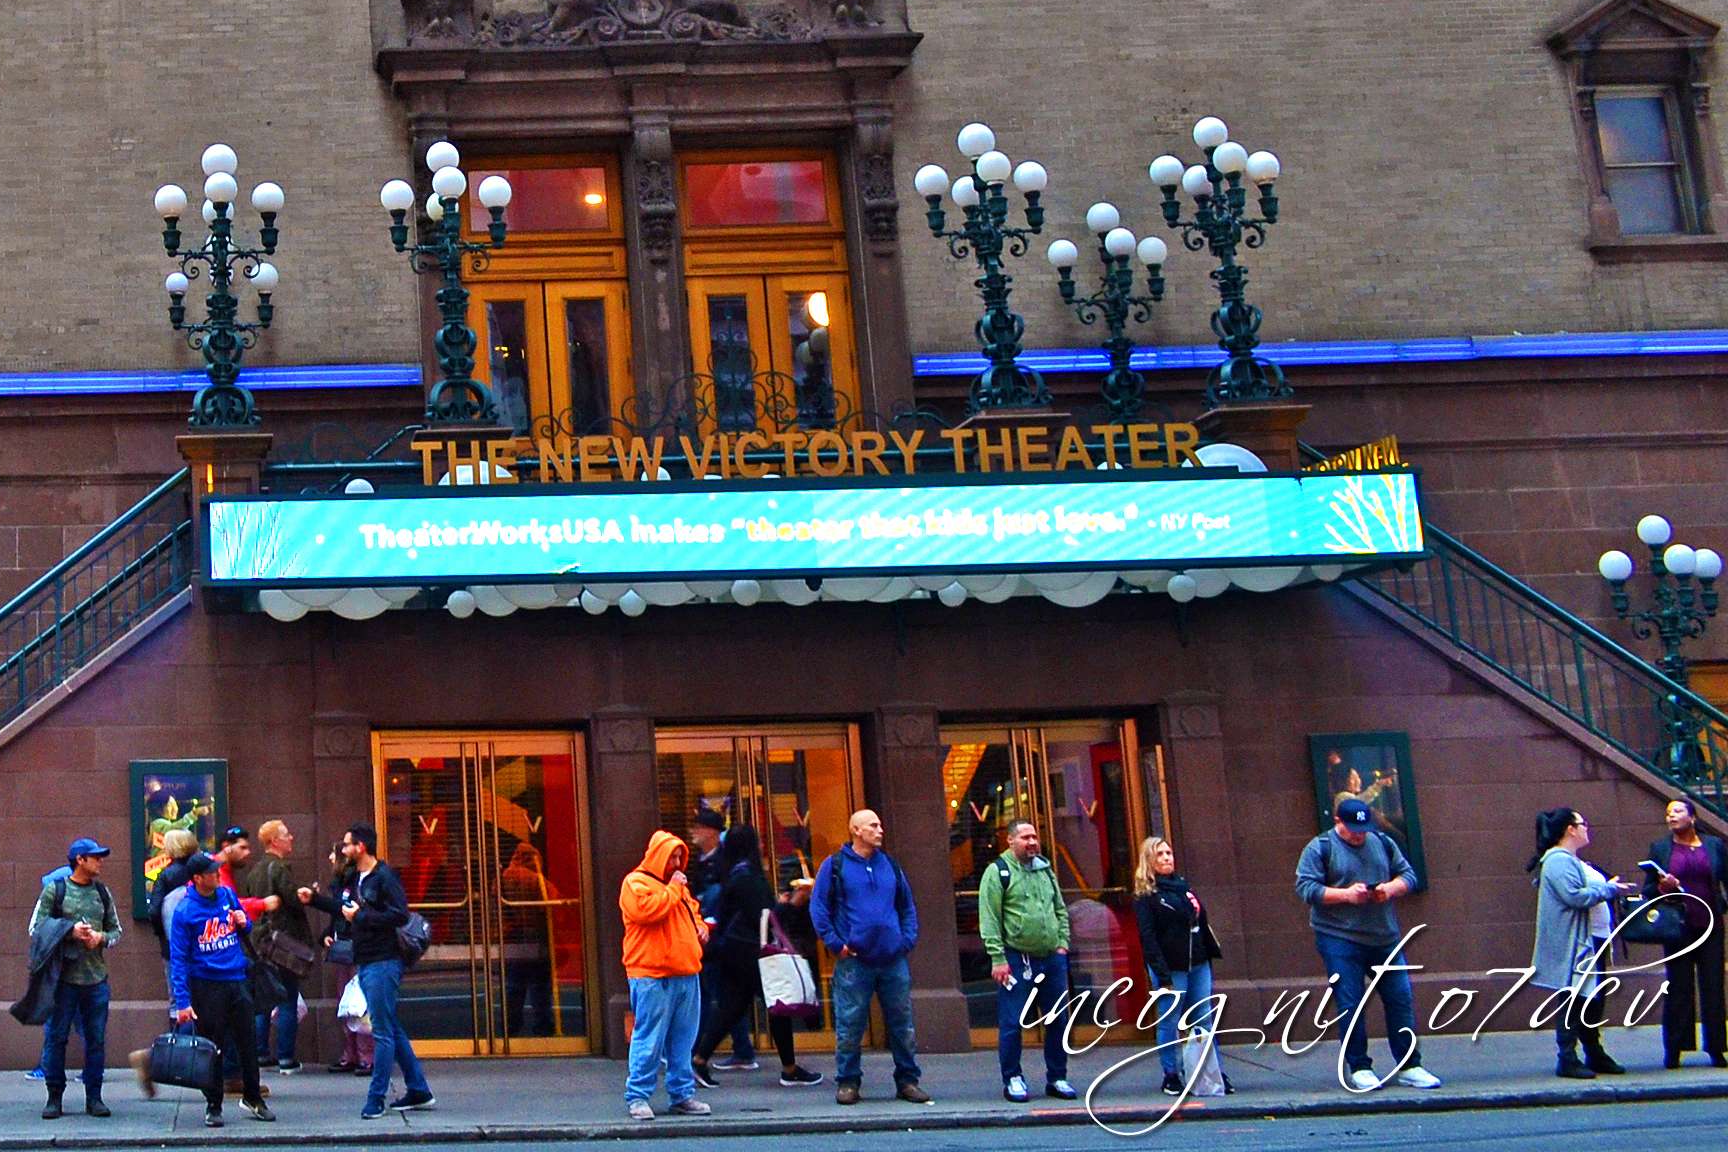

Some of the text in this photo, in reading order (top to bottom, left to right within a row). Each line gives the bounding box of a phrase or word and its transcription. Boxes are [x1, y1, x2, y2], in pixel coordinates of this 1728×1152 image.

[411, 422, 1204, 486] THE NEW VICTORY THEATER
